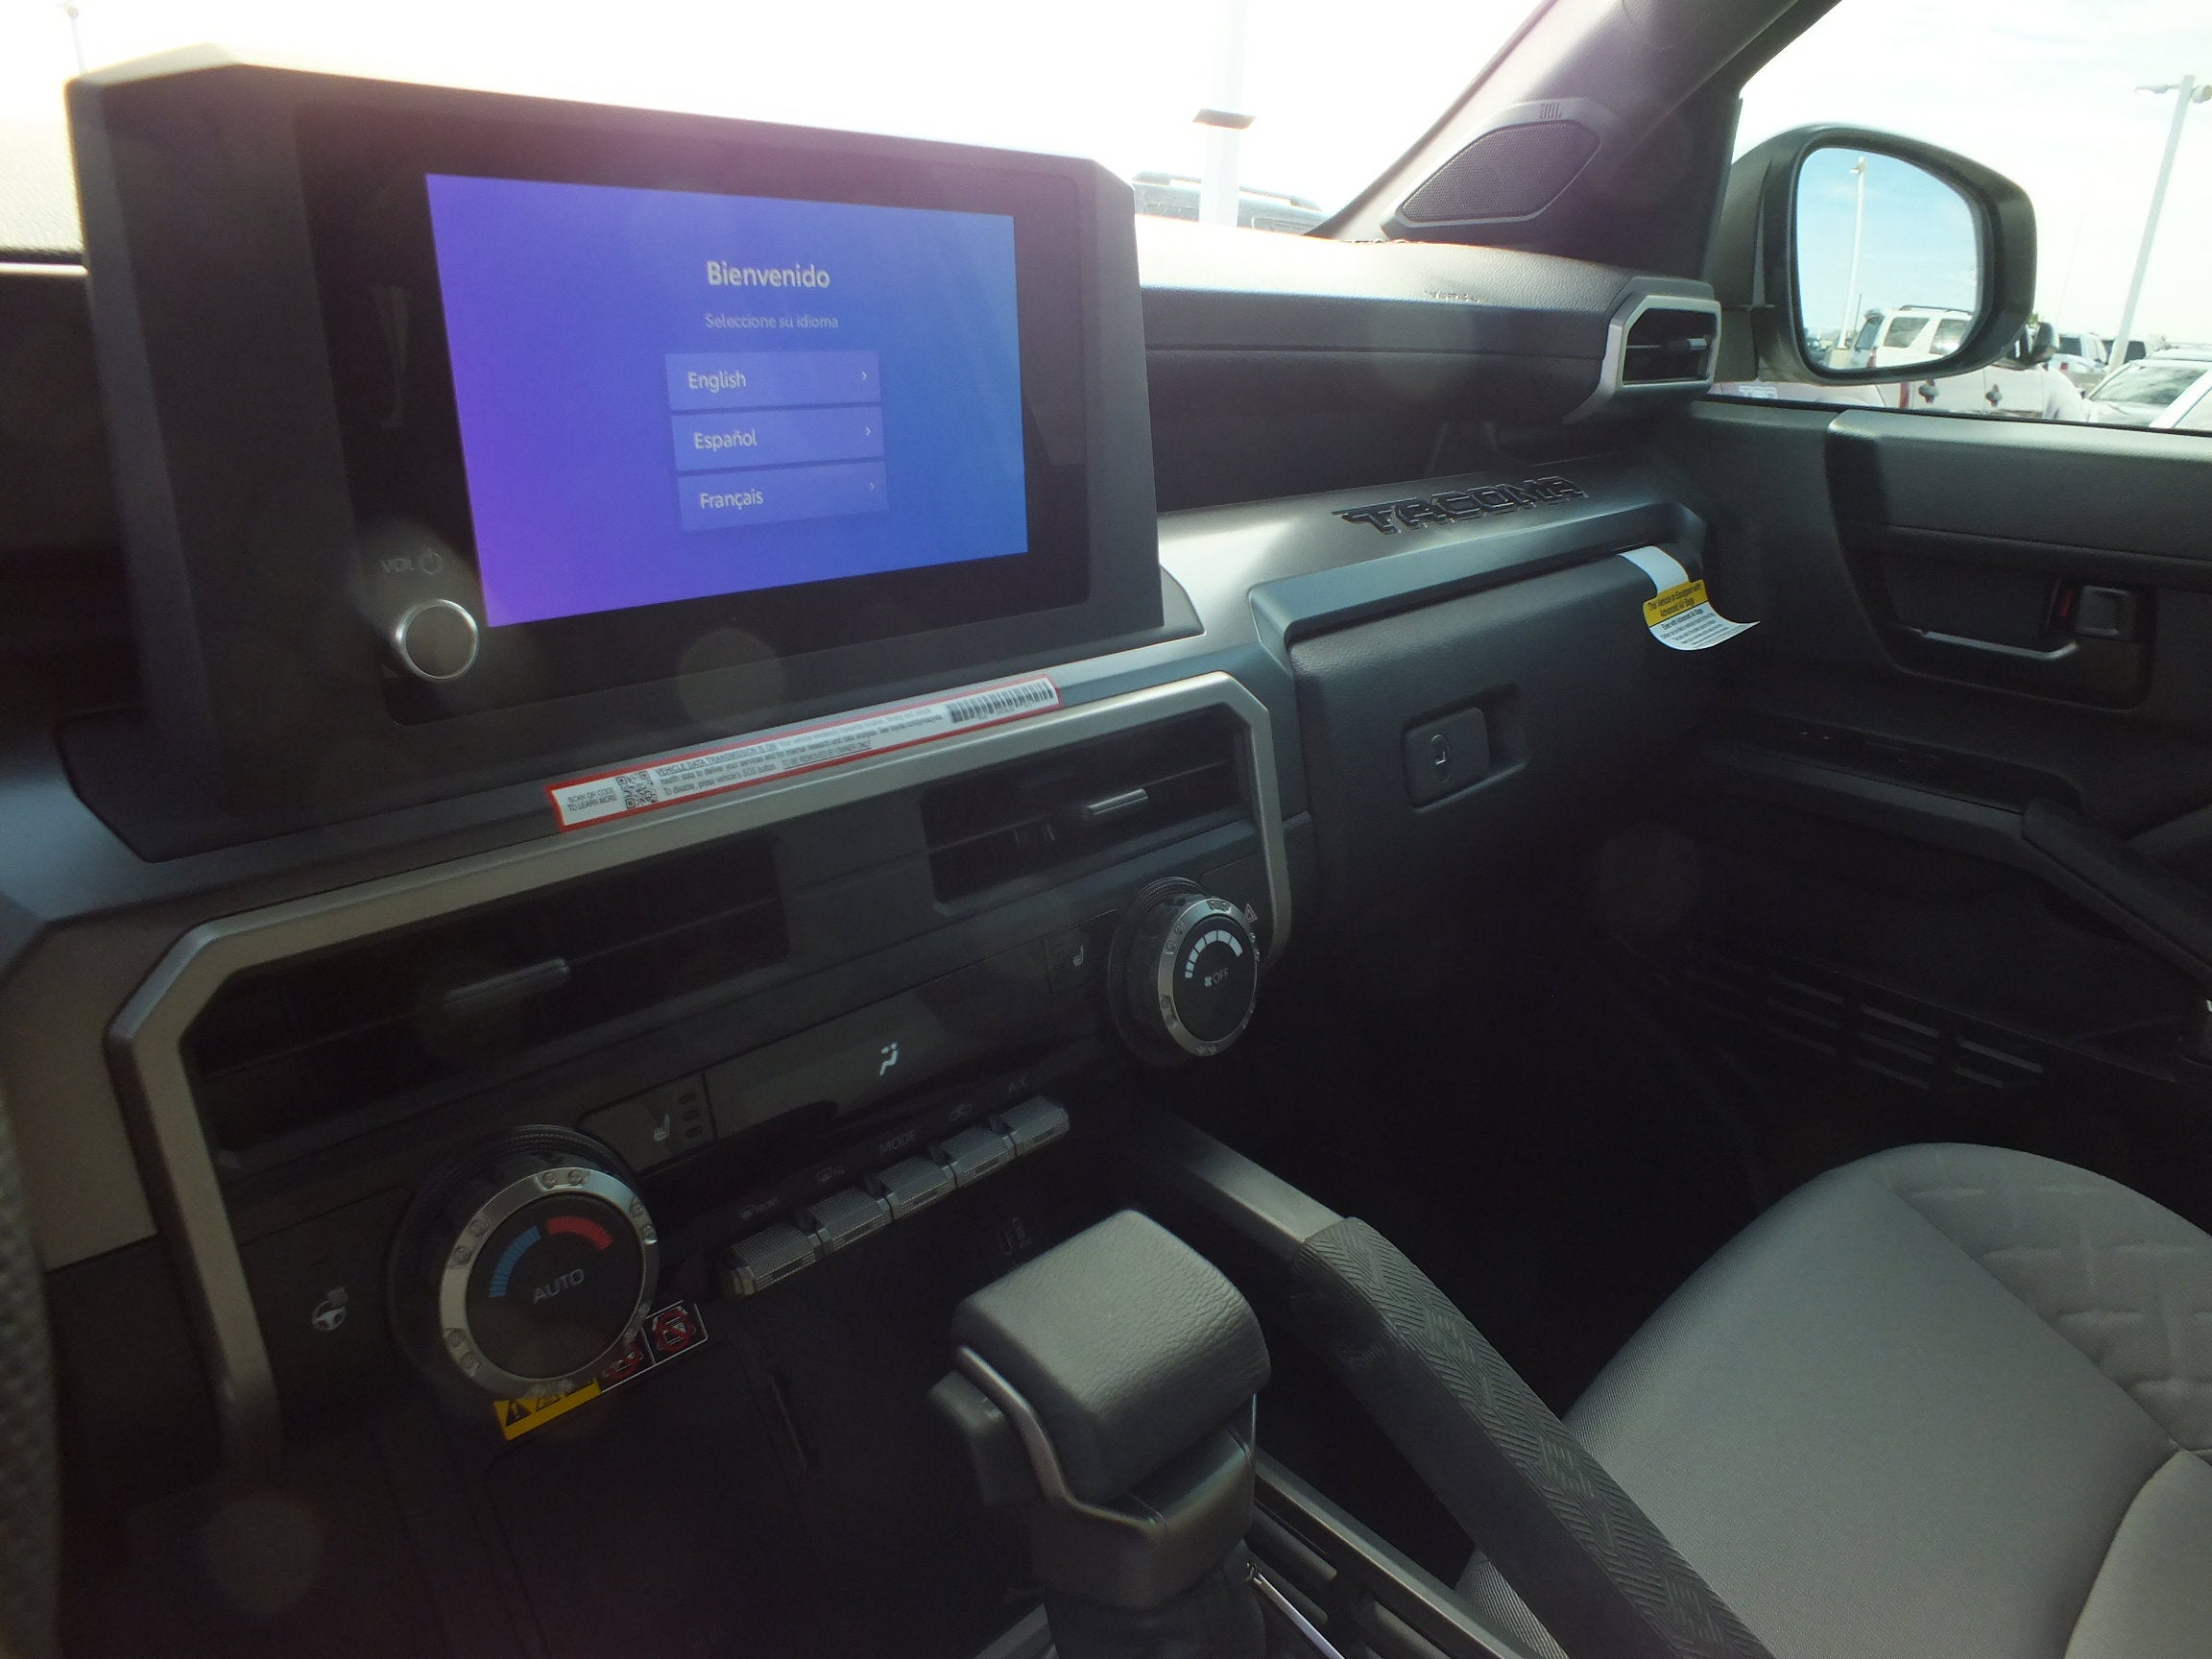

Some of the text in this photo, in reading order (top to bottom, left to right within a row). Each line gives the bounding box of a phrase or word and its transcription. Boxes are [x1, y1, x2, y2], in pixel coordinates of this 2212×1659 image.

[707, 260, 830, 288] Bienvenido
[705, 313, 839, 329] Seleccione su idioma
[687, 371, 747, 394] English
[693, 429, 757, 451] Español
[699, 488, 764, 511] Français
[1331, 475, 1590, 535] TACOMA
[1213, 968, 1229, 984] OFF
[533, 1268, 585, 1304] AUTO
